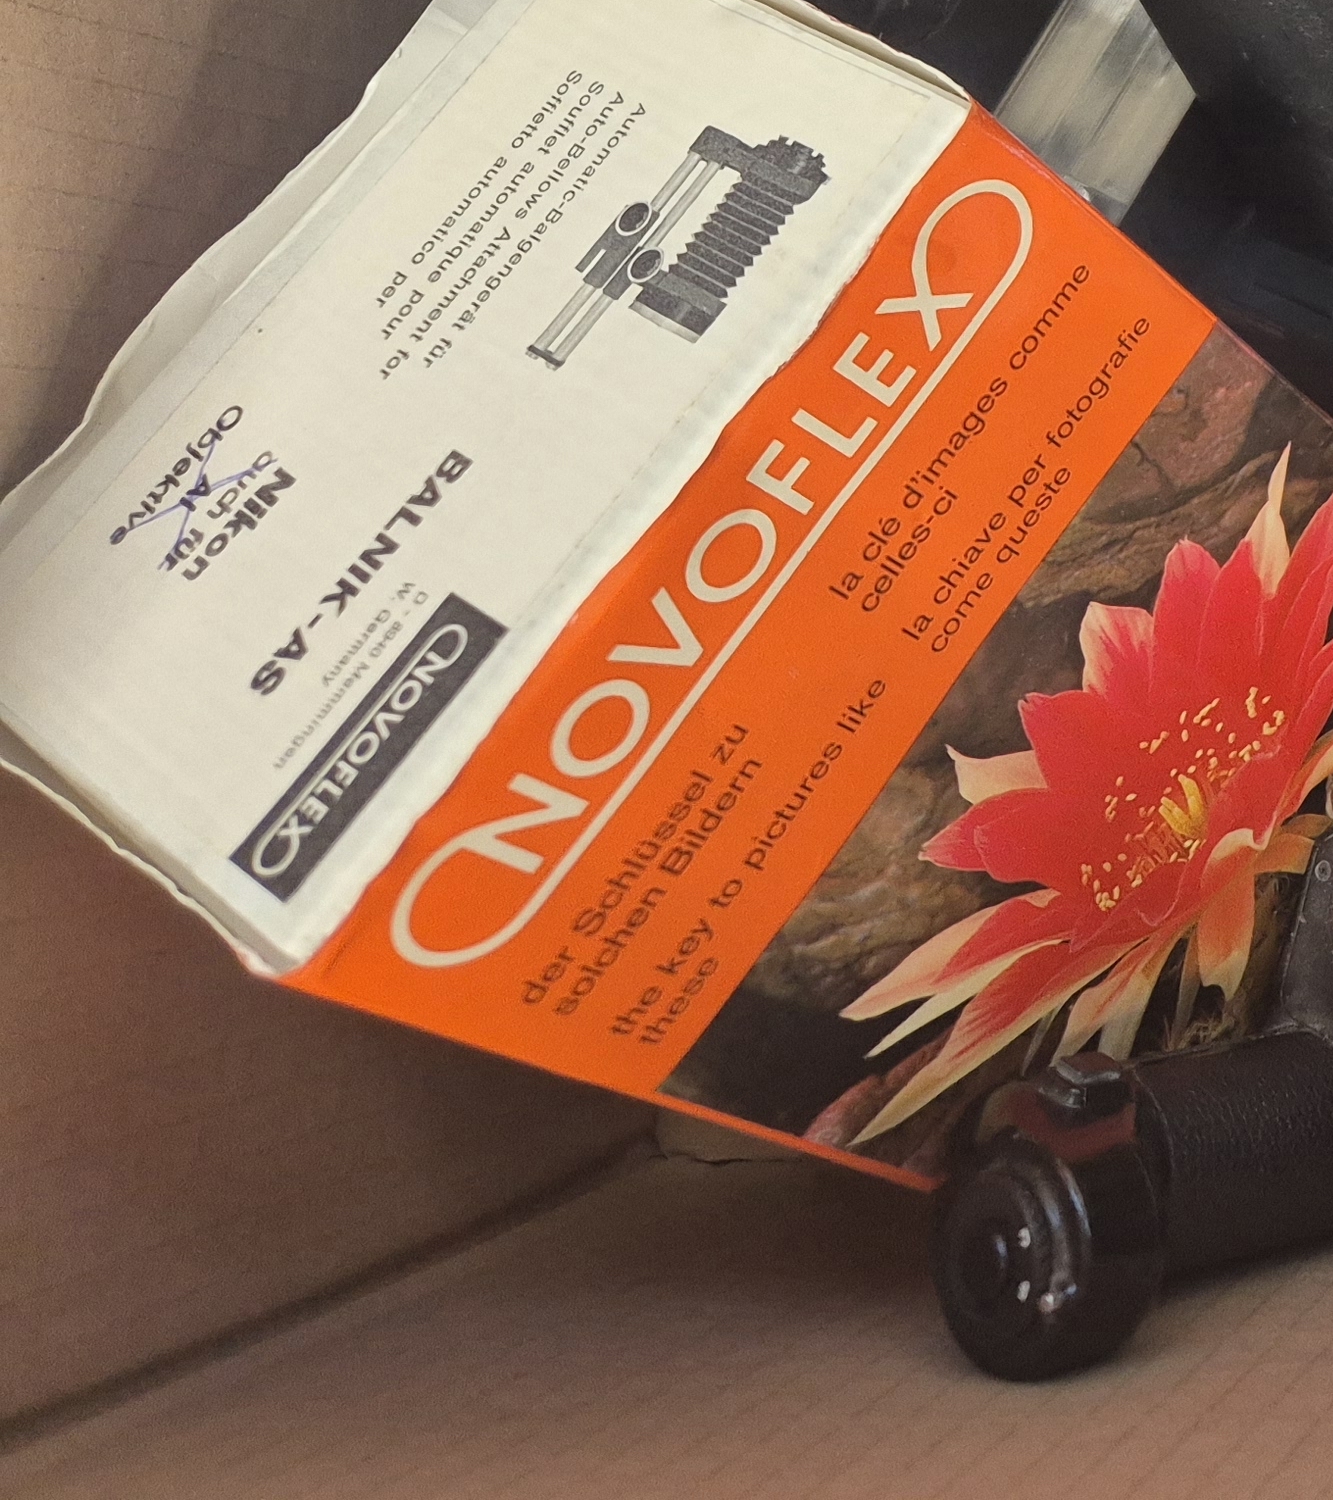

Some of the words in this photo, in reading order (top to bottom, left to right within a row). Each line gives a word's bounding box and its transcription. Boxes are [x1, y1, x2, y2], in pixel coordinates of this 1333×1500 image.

[511, 69, 584, 150] Soffietto
[514, 91, 625, 220] Auto-Bellows
[538, 80, 605, 155] Soufflet
[411, 156, 509, 266] automatico
[427, 161, 535, 284] automatique
[451, 103, 647, 332] Automatic-Balgengerät
[376, 271, 408, 309] per
[381, 289, 425, 341] pour
[409, 226, 512, 343] Attachment
[379, 349, 411, 380] for
[423, 337, 453, 369] für
[109, 405, 243, 545] Objektive
[207, 451, 274, 519] auch
[827, 571, 864, 602] la
[862, 515, 901, 563] clé
[1008, 263, 1090, 371] comme
[901, 614, 934, 641] la
[932, 511, 1007, 605] chiave
[1006, 453, 1047, 509] per
[1046, 317, 1151, 448] fotografie
[181, 467, 297, 581] Nikon
[391, 178, 1034, 968] NOVOFLEX
[860, 487, 959, 613] celles-ci
[930, 572, 994, 653] come
[996, 466, 1072, 564] queste
[321, 609, 391, 687] Germany
[252, 623, 469, 878] NOVOFLEX
[522, 945, 577, 1006] der
[570, 768, 714, 938] Schlüssel
[711, 723, 749, 765] zu
[552, 885, 669, 1017] solchen
[659, 758, 763, 877] Bildern
[610, 985, 663, 1038] the
[655, 917, 716, 976] key
[708, 878, 744, 910] to
[744, 740, 844, 873] pictures
[836, 678, 887, 735] like
[638, 956, 719, 1046] these
